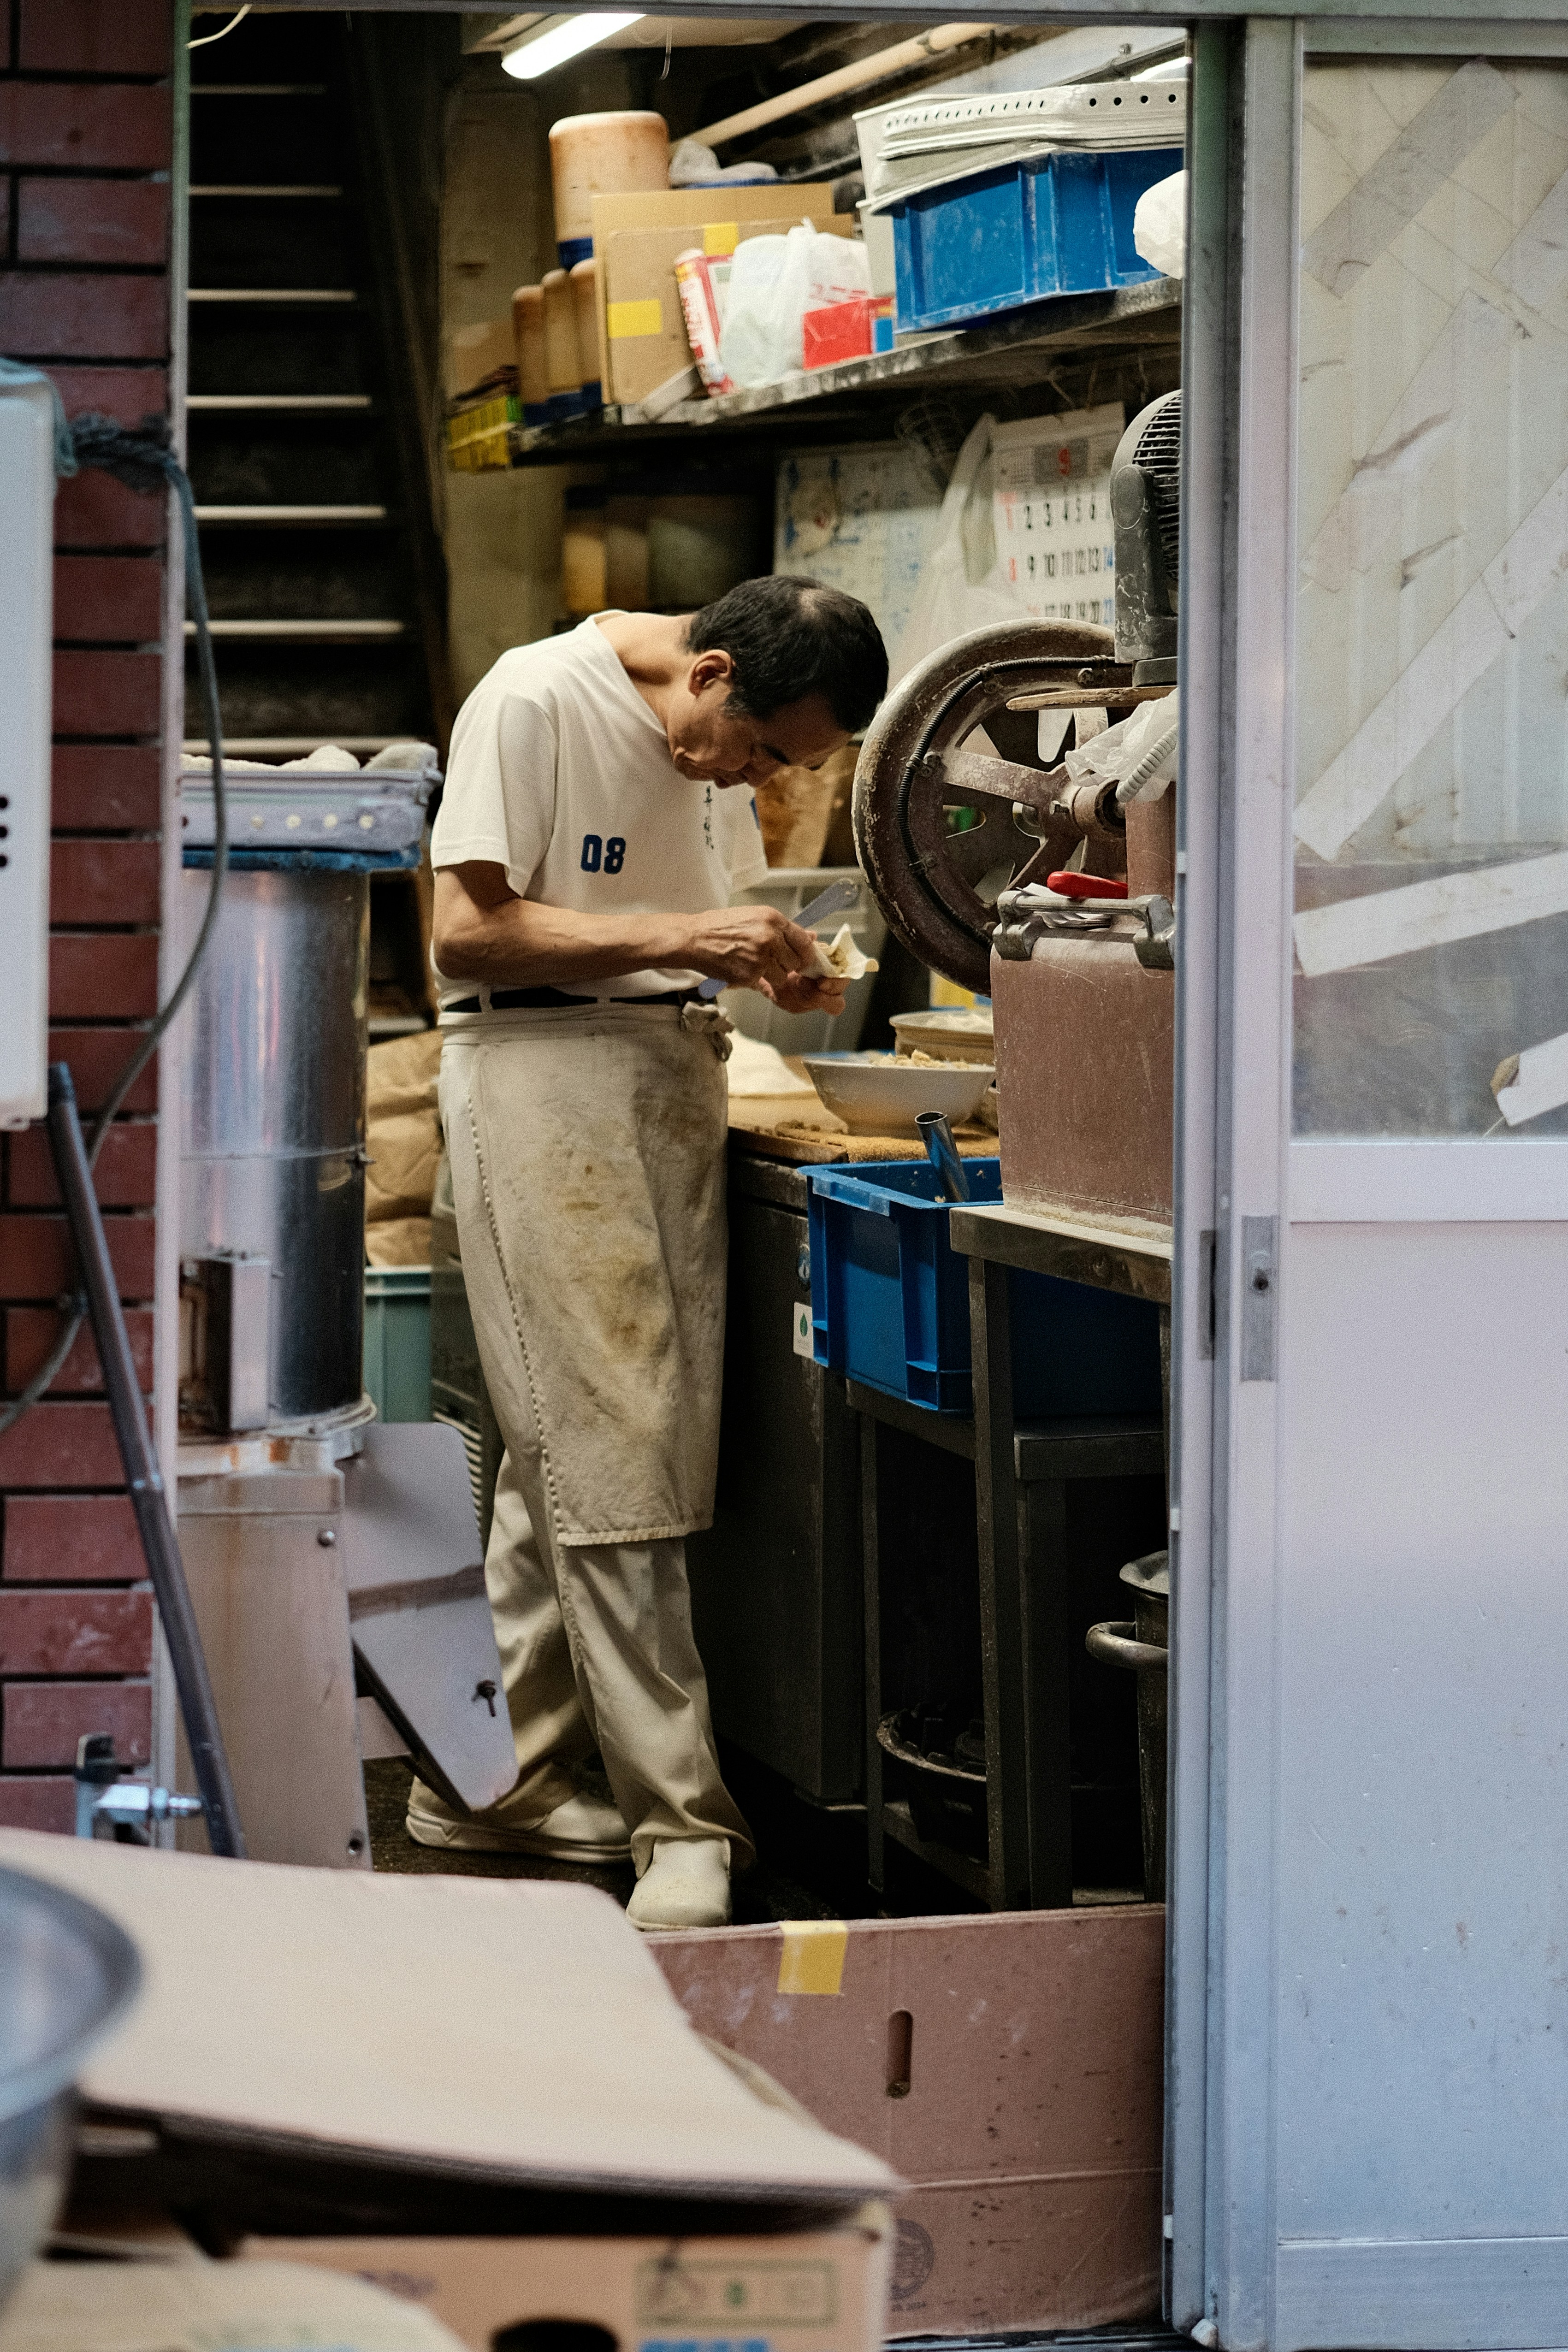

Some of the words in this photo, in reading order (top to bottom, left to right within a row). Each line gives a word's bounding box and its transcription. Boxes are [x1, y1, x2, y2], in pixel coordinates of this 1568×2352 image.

[1024, 505, 1033, 530] 2
[1044, 502, 1051, 526] 3
[1044, 553, 1056, 578] 10
[1075, 549, 1086, 575] 12
[1088, 547, 1100, 573] 13
[580, 834, 626, 875] 08
